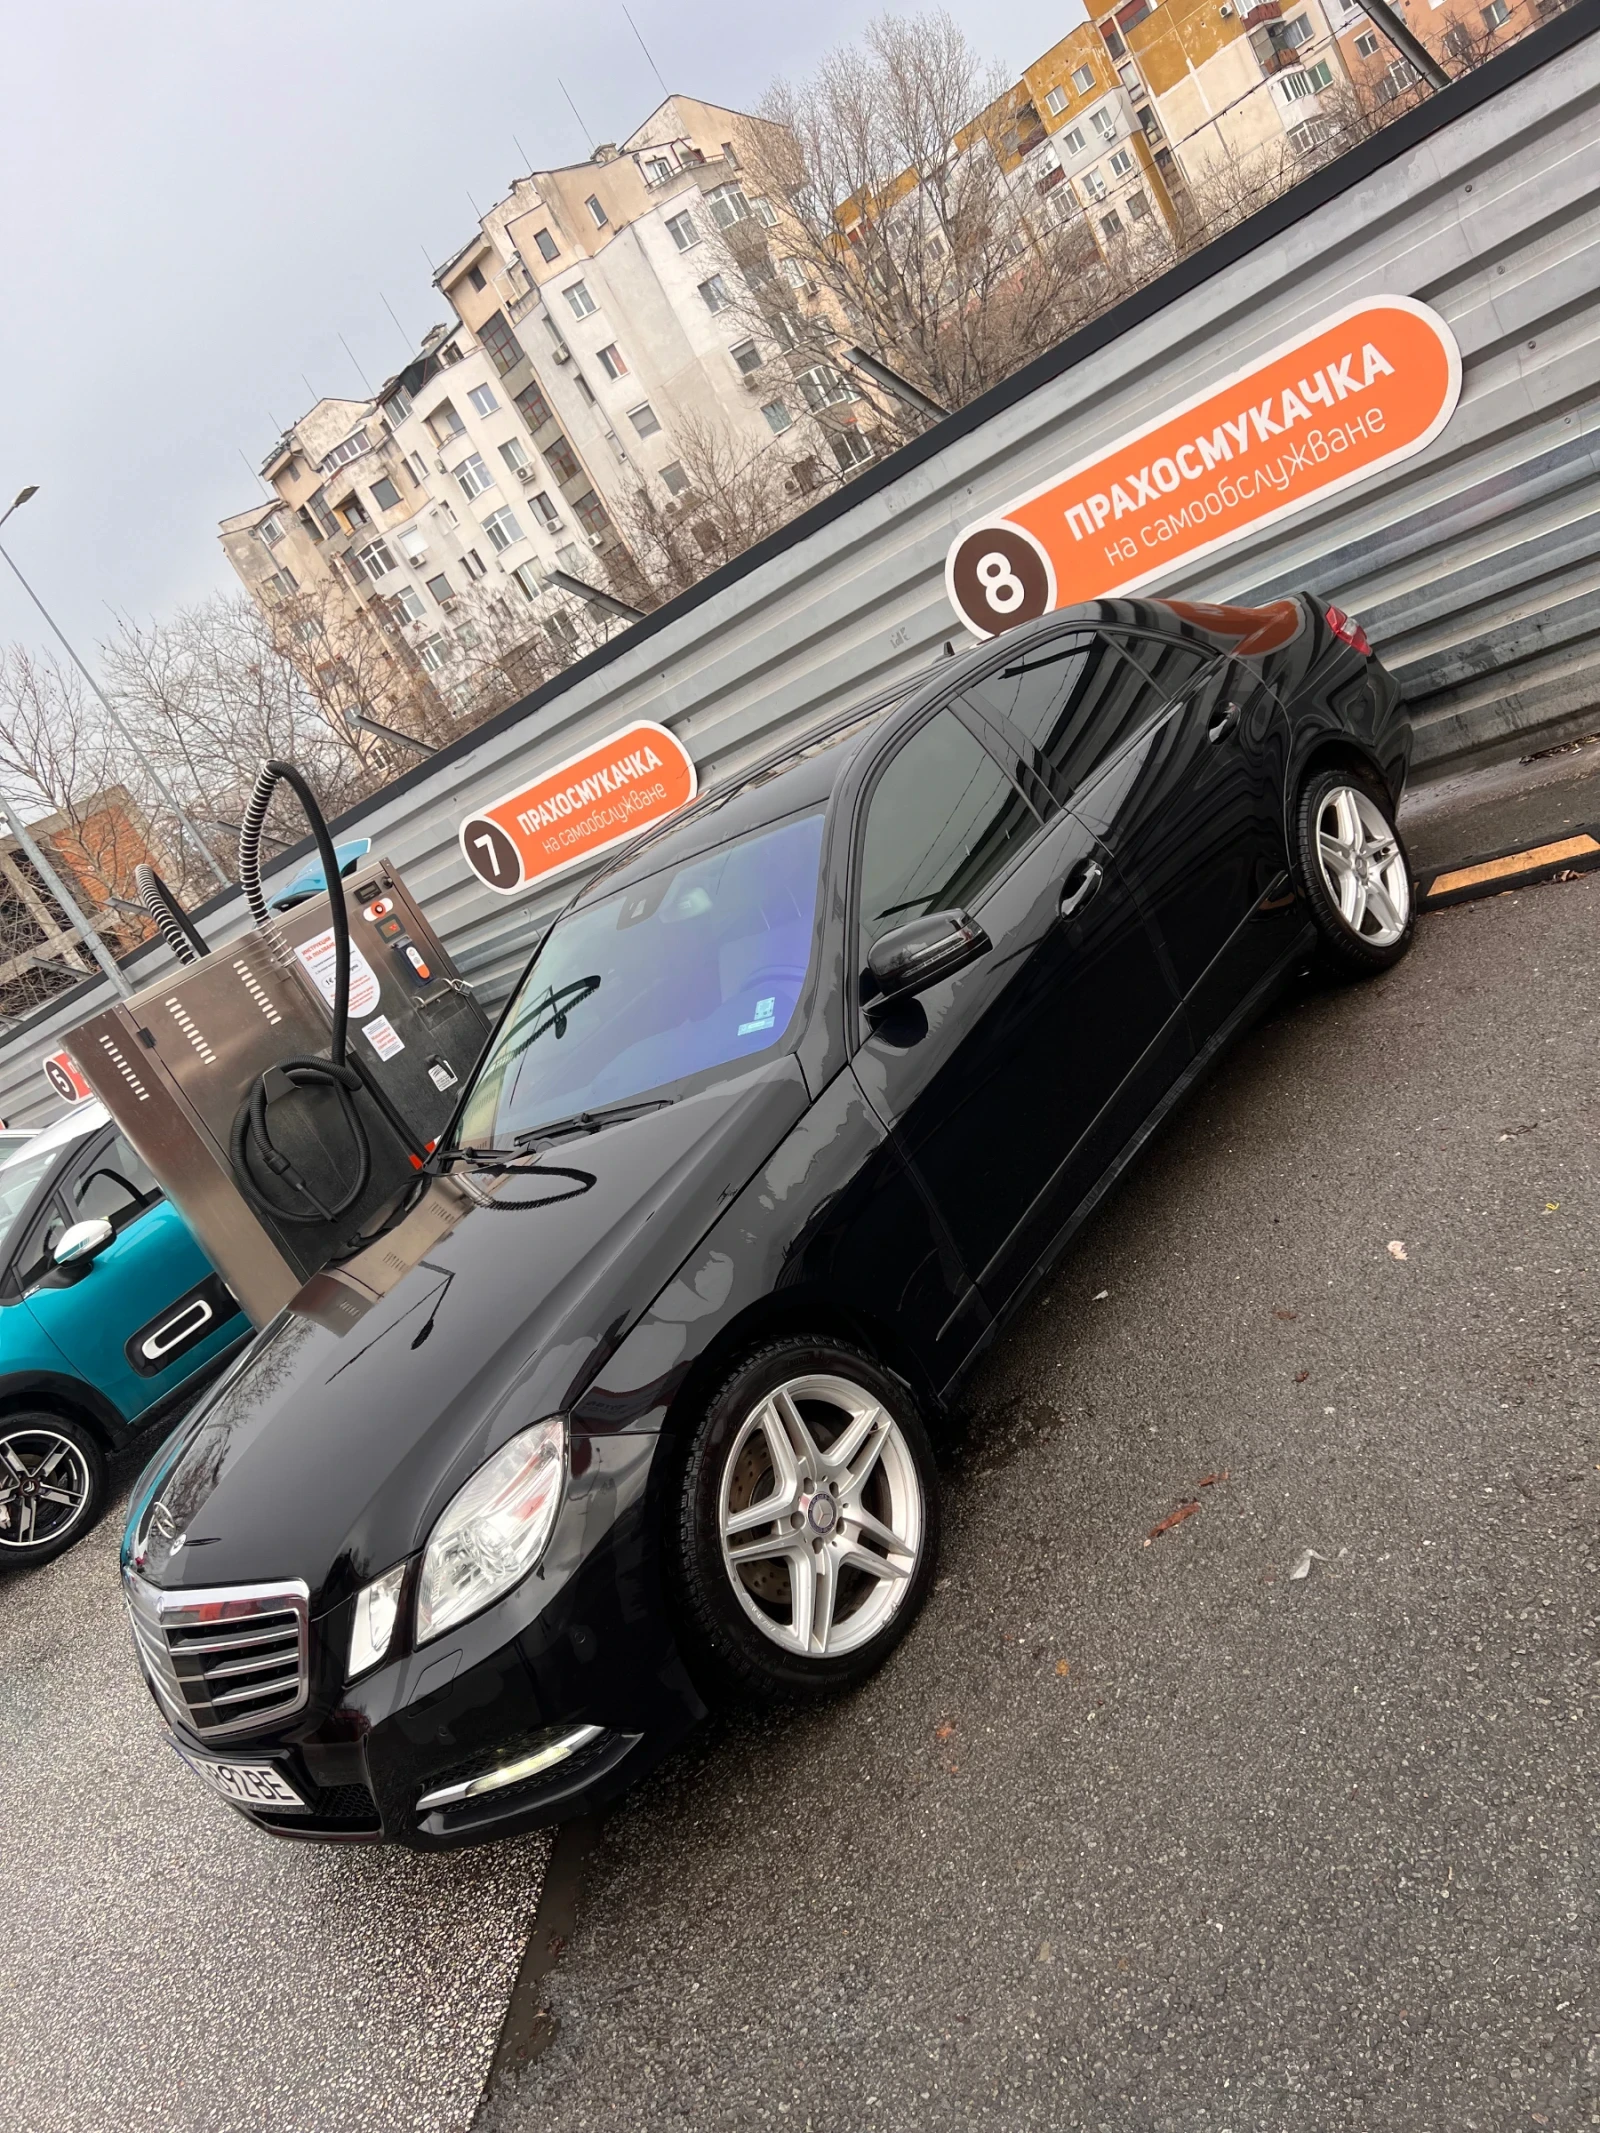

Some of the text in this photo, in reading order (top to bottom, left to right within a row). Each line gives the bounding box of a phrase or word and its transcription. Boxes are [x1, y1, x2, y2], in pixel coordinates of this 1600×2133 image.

[1064, 342, 1395, 541] ПРАХОСМУКАЧКА
[1105, 407, 1386, 566] на самообслужване
[976, 552, 1025, 614] 8
[516, 746, 663, 836] ПРАХОСМУКАЧКА
[542, 783, 667, 854] на самообслужване
[473, 834, 500, 876] 7
[51, 1069, 70, 1092] 5
